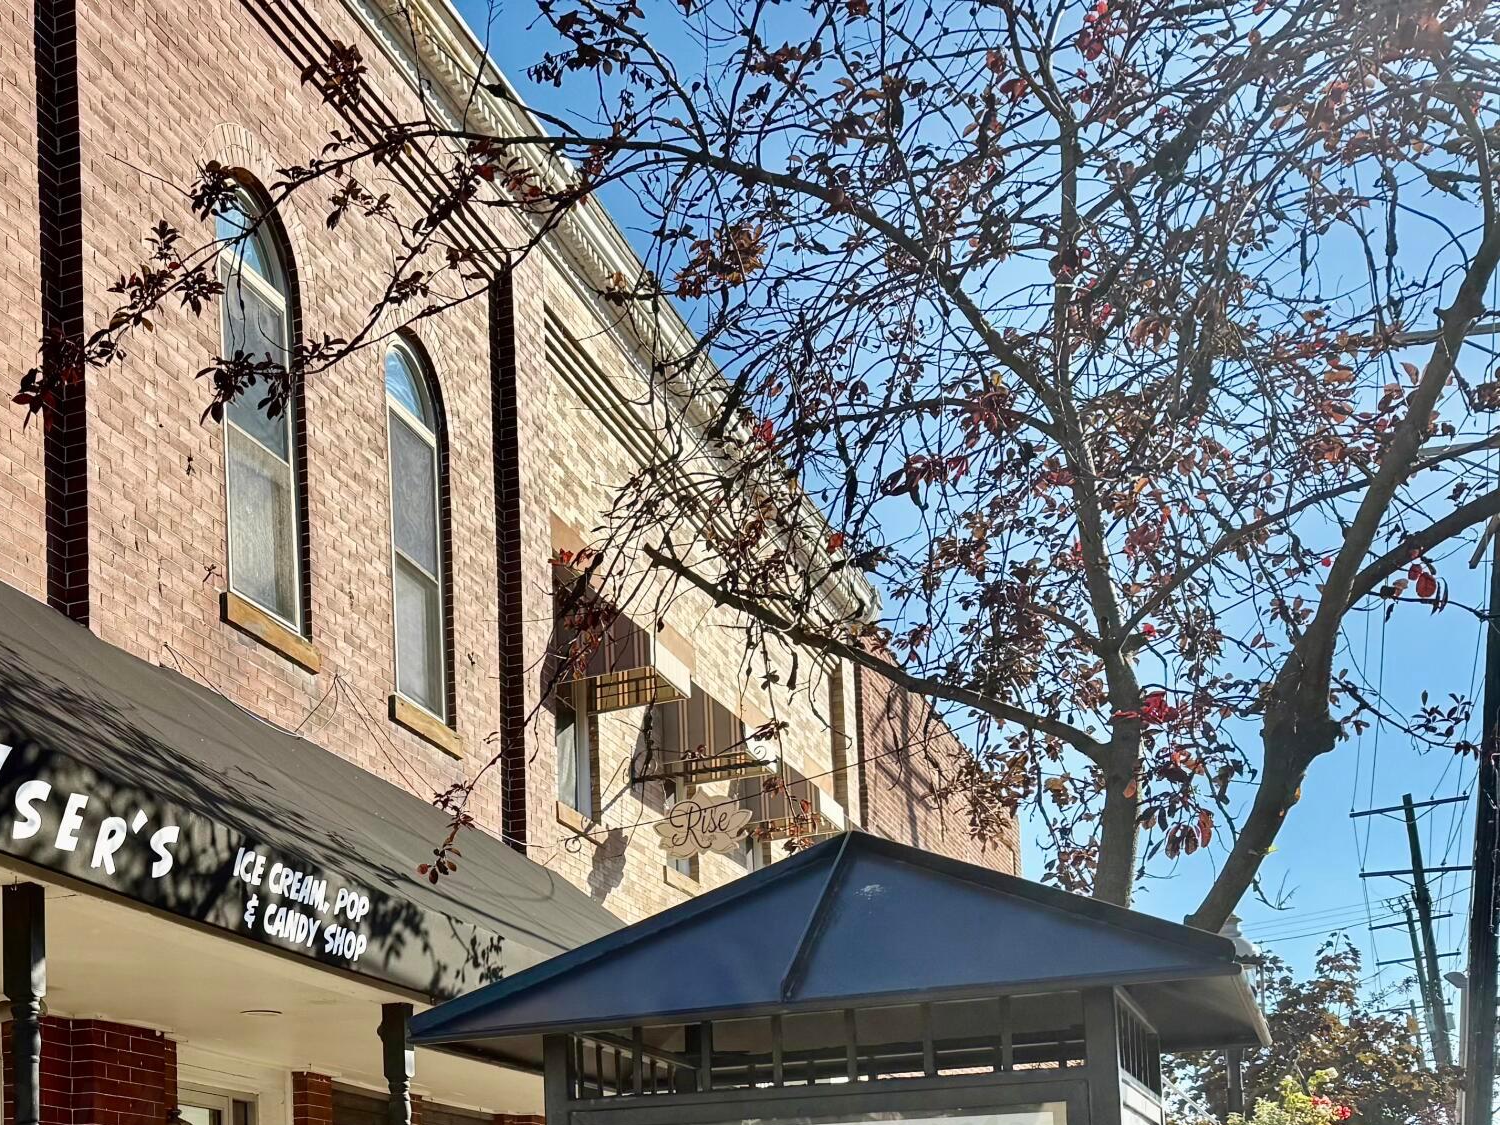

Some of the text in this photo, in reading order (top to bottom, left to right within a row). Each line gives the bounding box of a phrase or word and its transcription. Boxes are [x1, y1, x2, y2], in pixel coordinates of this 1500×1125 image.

[670, 801, 729, 848] Rise
[233, 847, 267, 886] ICE
[334, 887, 370, 923] POP
[244, 893, 368, 962] & CANDY SHOP
